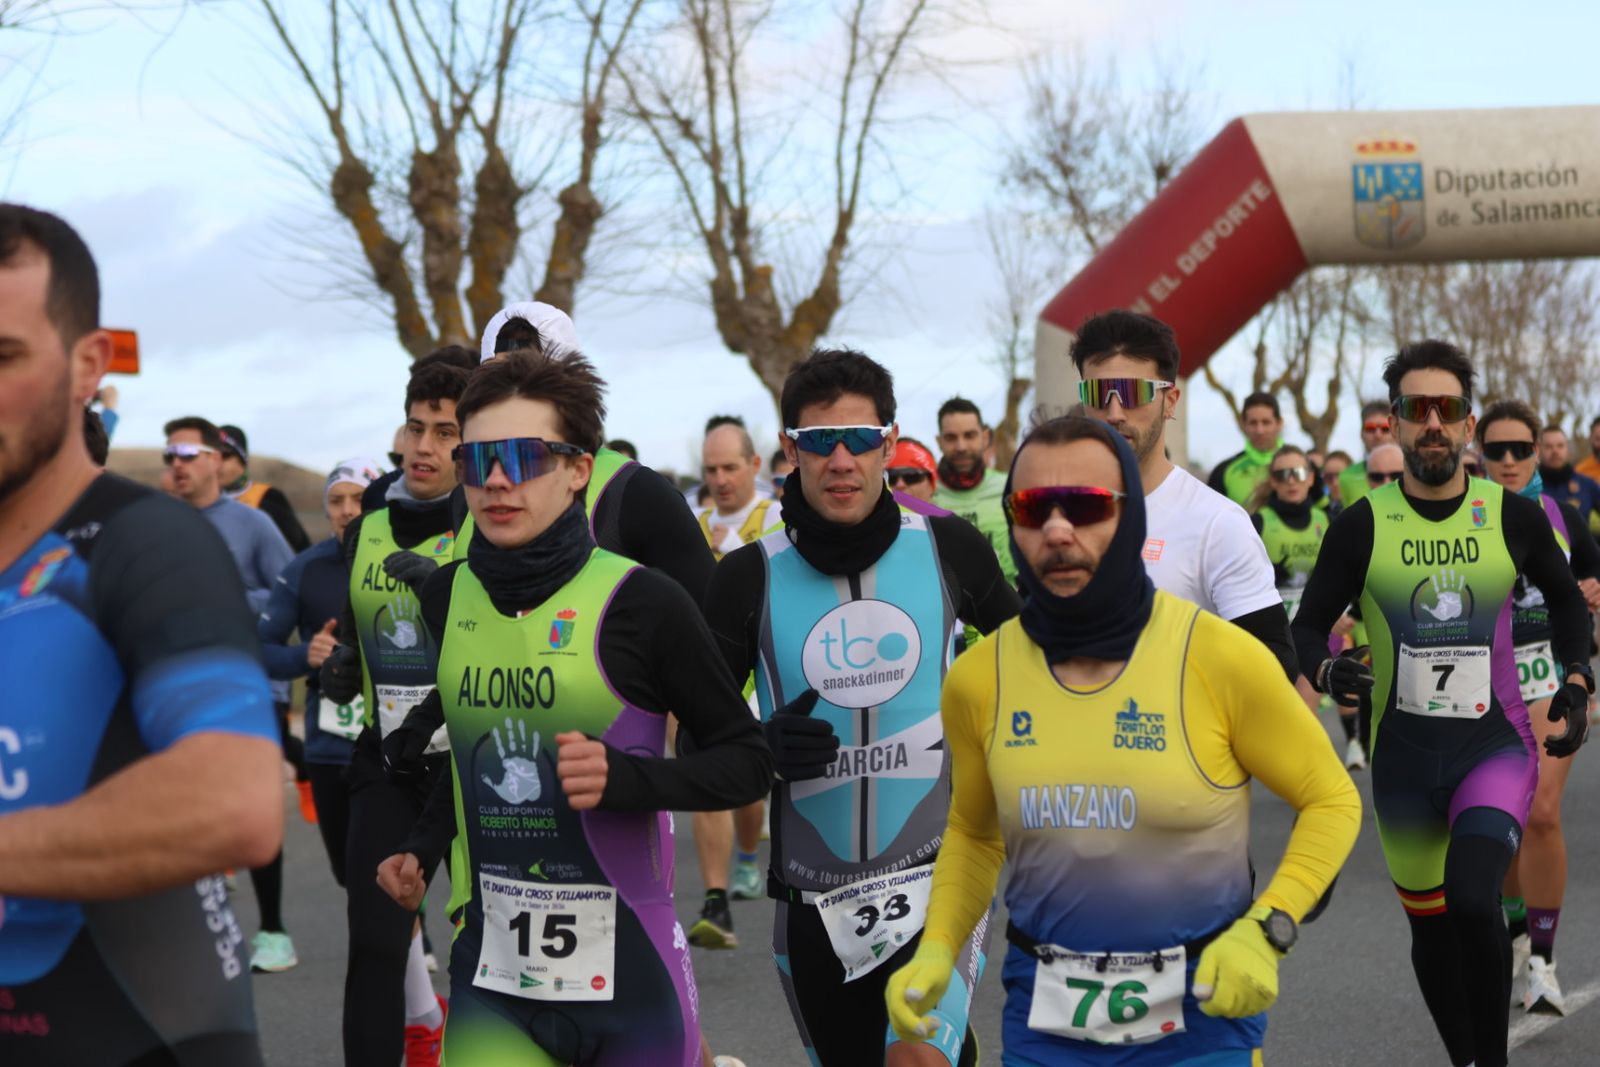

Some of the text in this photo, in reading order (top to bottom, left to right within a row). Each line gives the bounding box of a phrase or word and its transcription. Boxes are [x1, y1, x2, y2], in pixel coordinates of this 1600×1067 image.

[1434, 160, 1579, 198] Diputación
[1436, 207, 1461, 227] de
[1148, 178, 1272, 303] EL DEPORTE
[1401, 536, 1480, 567] CIUDAD
[1433, 650, 1452, 658] CROSS
[458, 666, 555, 709] ALONSO
[823, 668, 906, 690] snack&dinner
[1432, 664, 1455, 692] 7
[1114, 734, 1166, 752] DUERO
[479, 806, 554, 816] CLUB DEPORTIVO
[1020, 784, 1136, 830] MANZANO
[480, 815, 557, 829] ROBERTO RAMOS
[481, 880, 612, 901] VI DUATLÓN CROSS VILLAMAYOR
[830, 887, 860, 905] DUATLÓN
[861, 879, 886, 894] CROSS
[853, 894, 911, 937] 33
[509, 911, 577, 959] 15
[526, 965, 548, 973] MARIO
[1066, 977, 1149, 1028] 76
